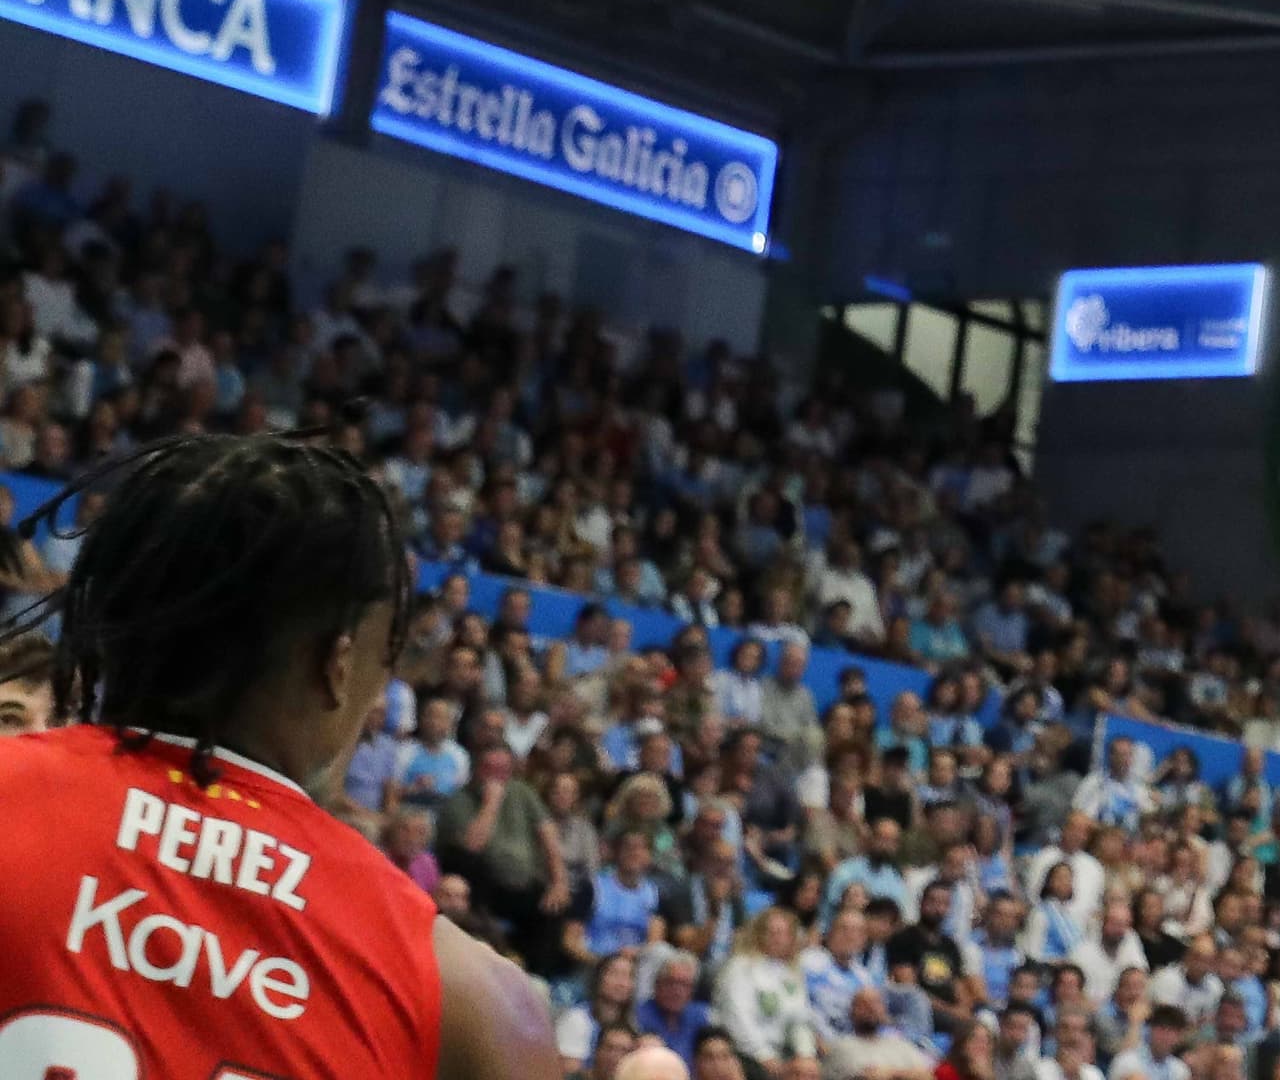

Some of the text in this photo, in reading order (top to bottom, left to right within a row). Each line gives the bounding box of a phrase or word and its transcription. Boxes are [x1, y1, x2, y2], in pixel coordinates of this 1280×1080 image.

[381, 47, 710, 210] Estrella Galicia
[116, 786, 312, 912] PEREZ
[65, 874, 311, 1020] Kave
